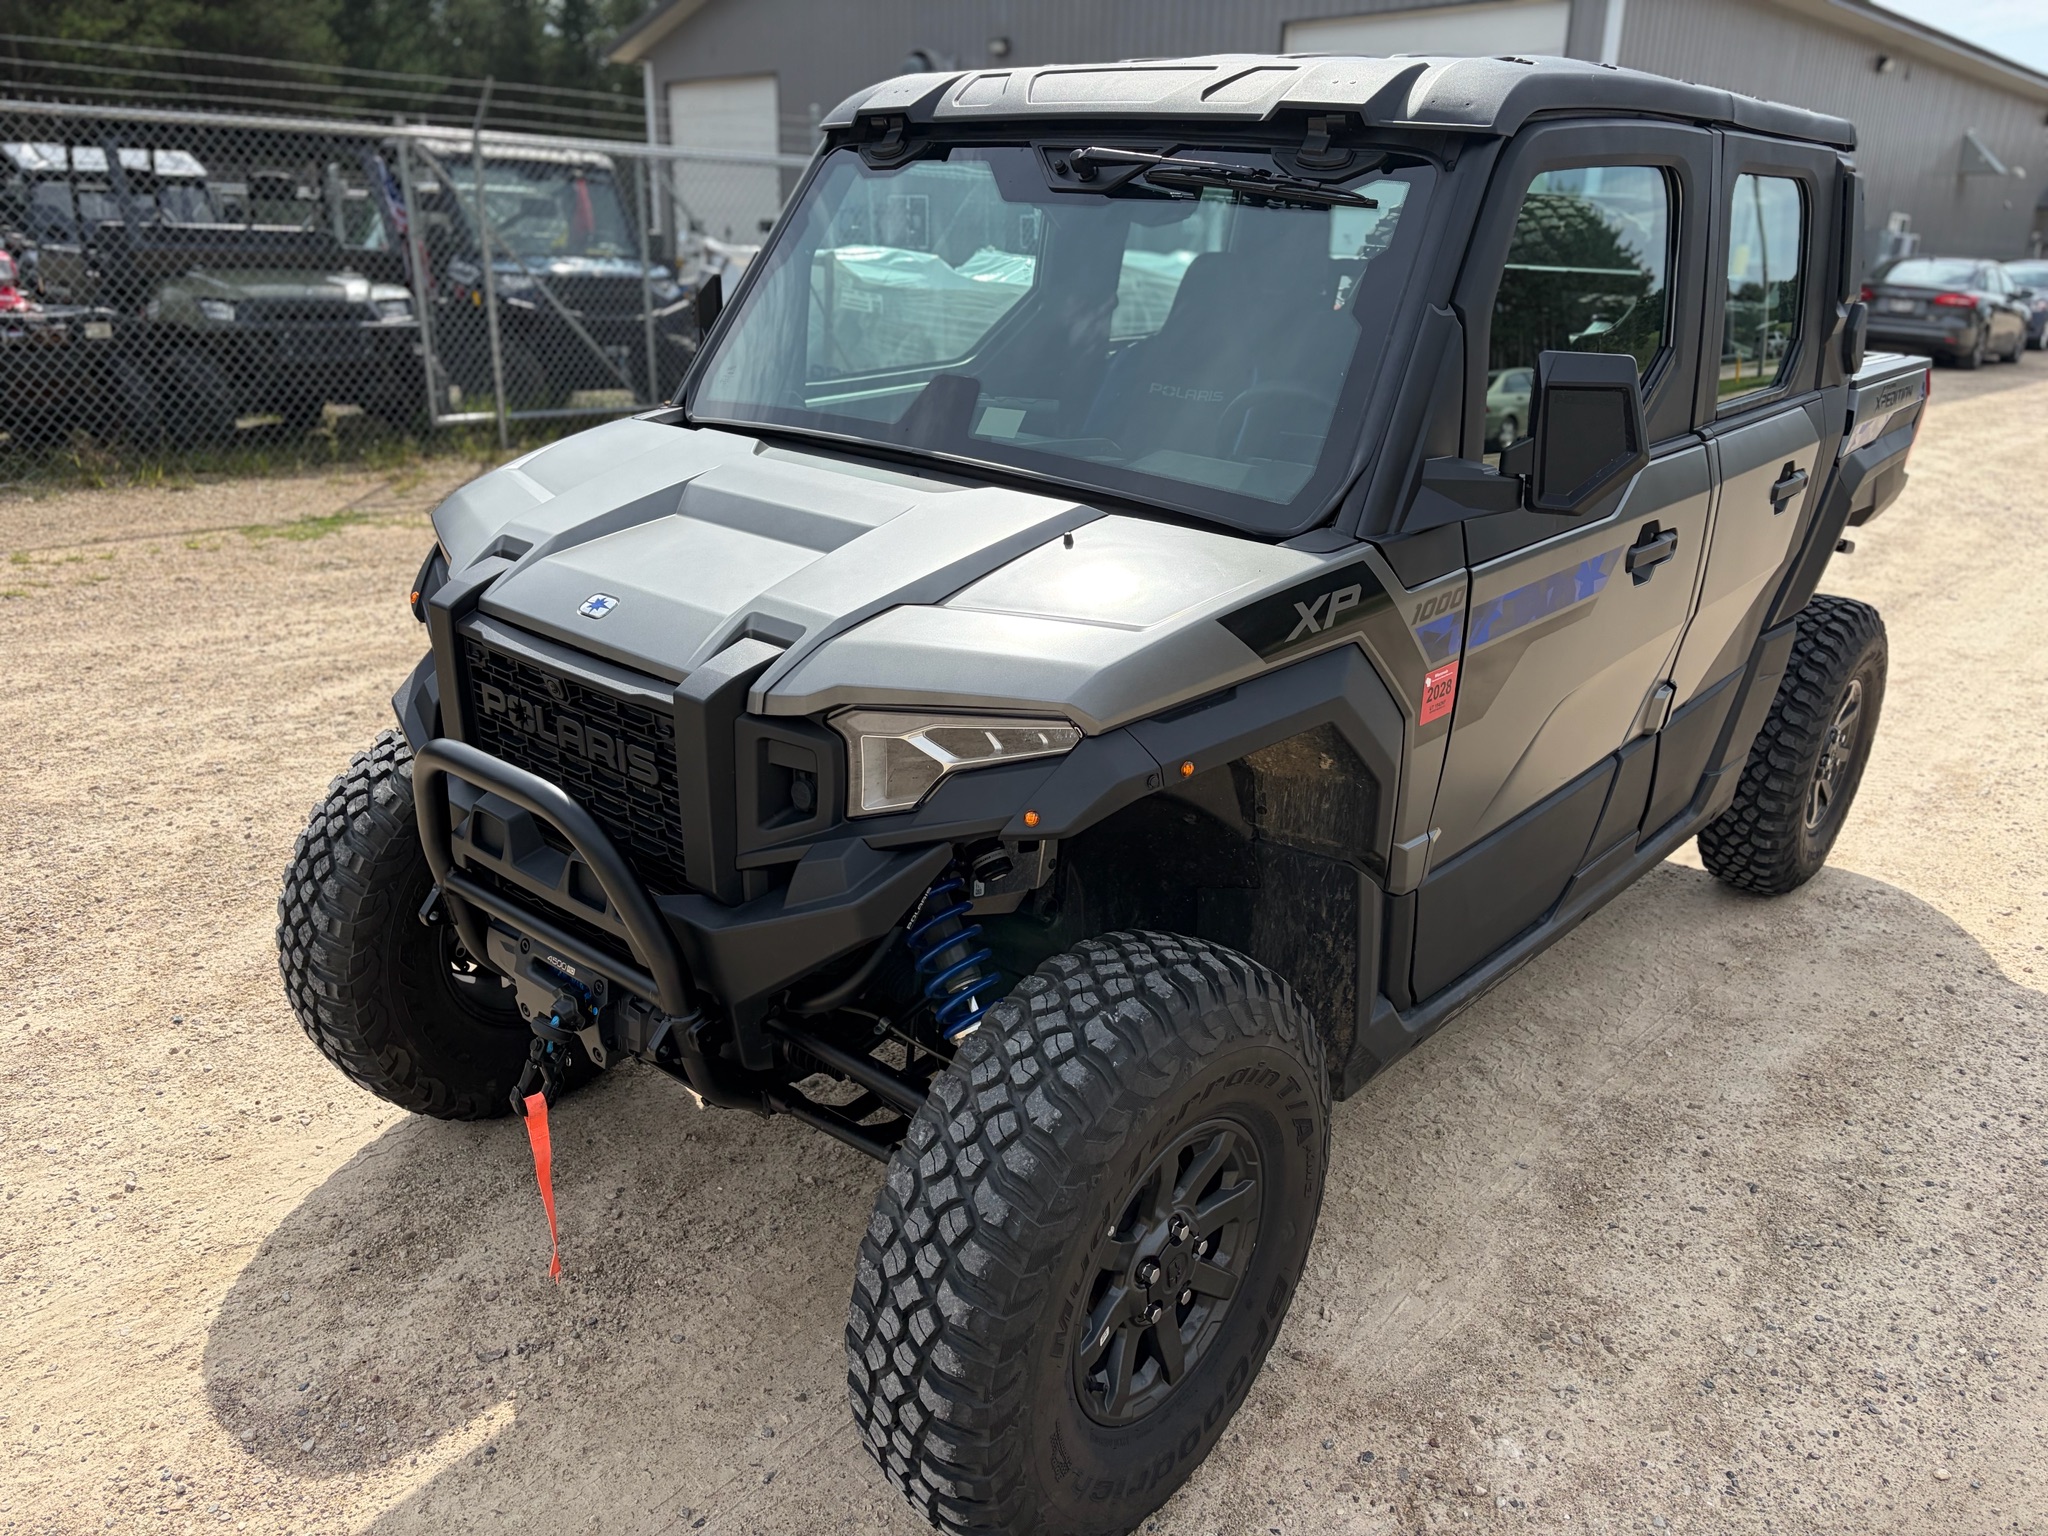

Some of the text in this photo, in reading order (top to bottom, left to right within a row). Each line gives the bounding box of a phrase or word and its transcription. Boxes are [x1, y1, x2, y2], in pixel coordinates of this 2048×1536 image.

[1149, 382, 1224, 402] POLARIS
[1284, 583, 1362, 643] XP
[1411, 585, 1466, 626] 1000
[1426, 679, 1452, 703] 2028
[481, 682, 659, 786] POLARIS
[906, 886, 932, 930] POLARIS
[547, 955, 568, 971] 4500
[1070, 1273, 1289, 1502] BFGoodrich
